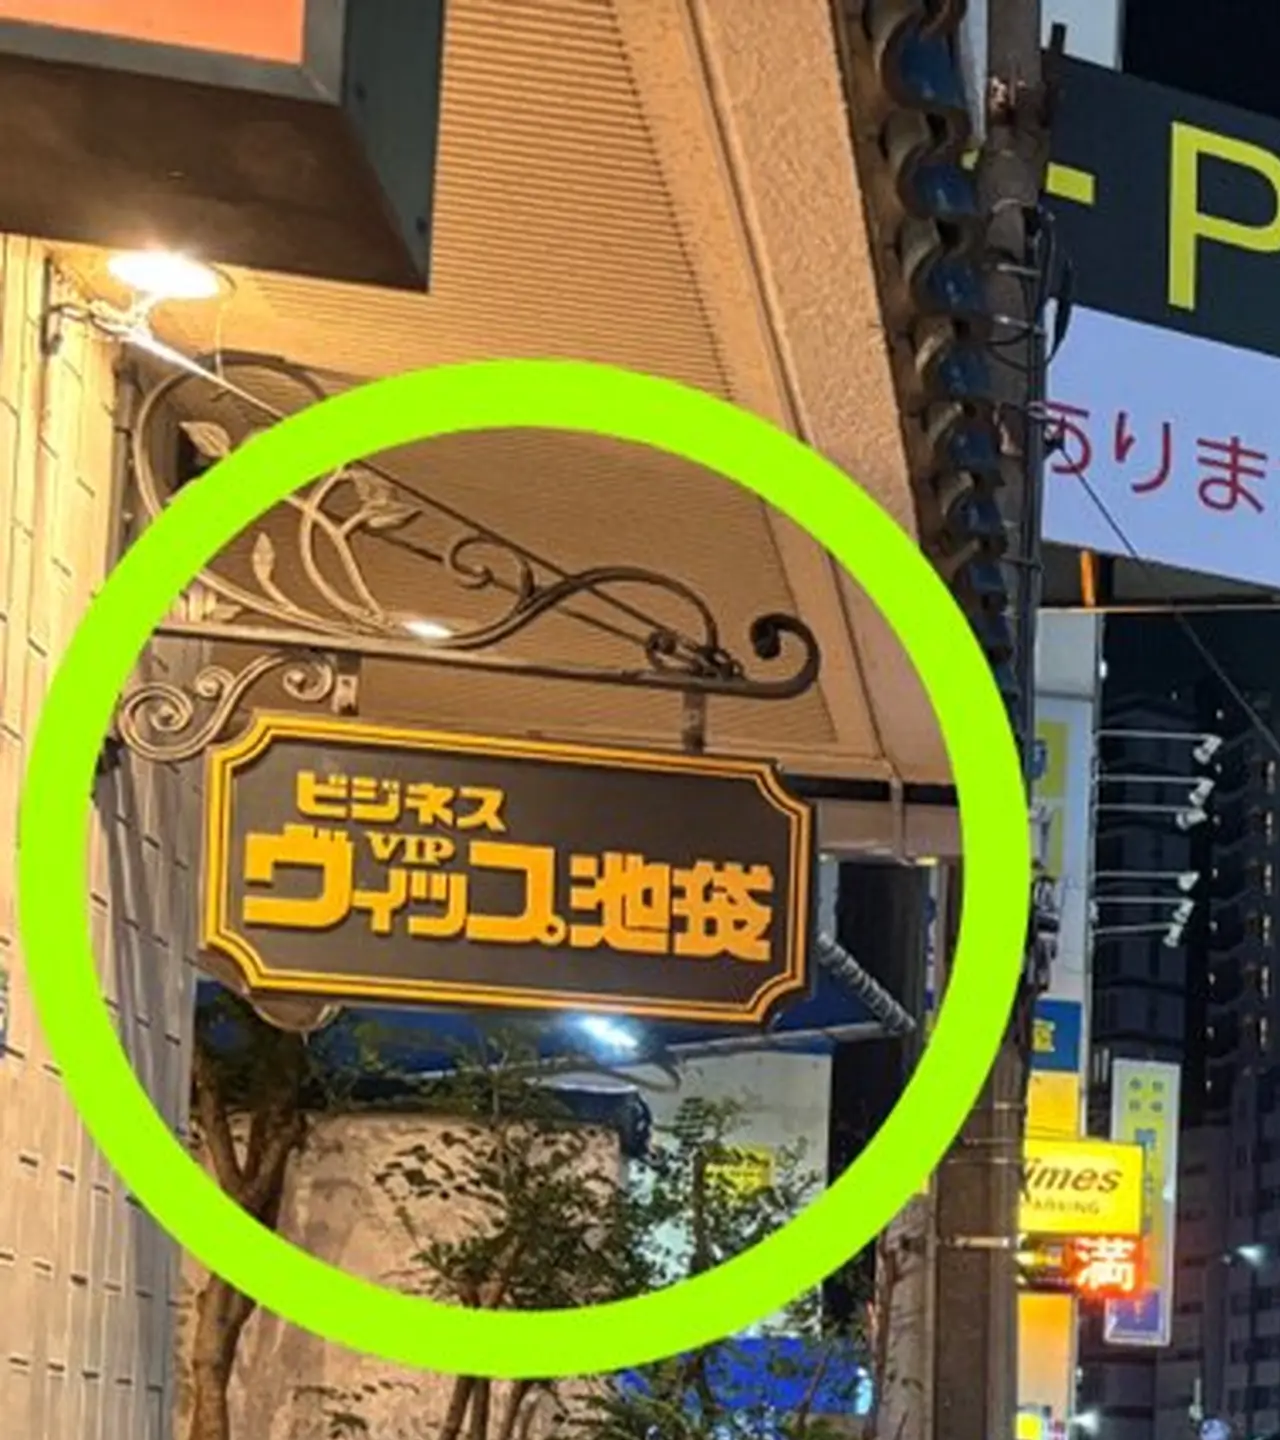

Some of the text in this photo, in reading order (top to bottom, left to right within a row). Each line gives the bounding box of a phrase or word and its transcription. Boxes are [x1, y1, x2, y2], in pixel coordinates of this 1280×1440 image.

[296, 770, 506, 832] ビジネス
[366, 831, 455, 866] VIP
[243, 823, 772, 962] ヴィップ池袋
[1024, 1157, 1123, 1194] imes
[1032, 1198, 1100, 1217] ARKING
